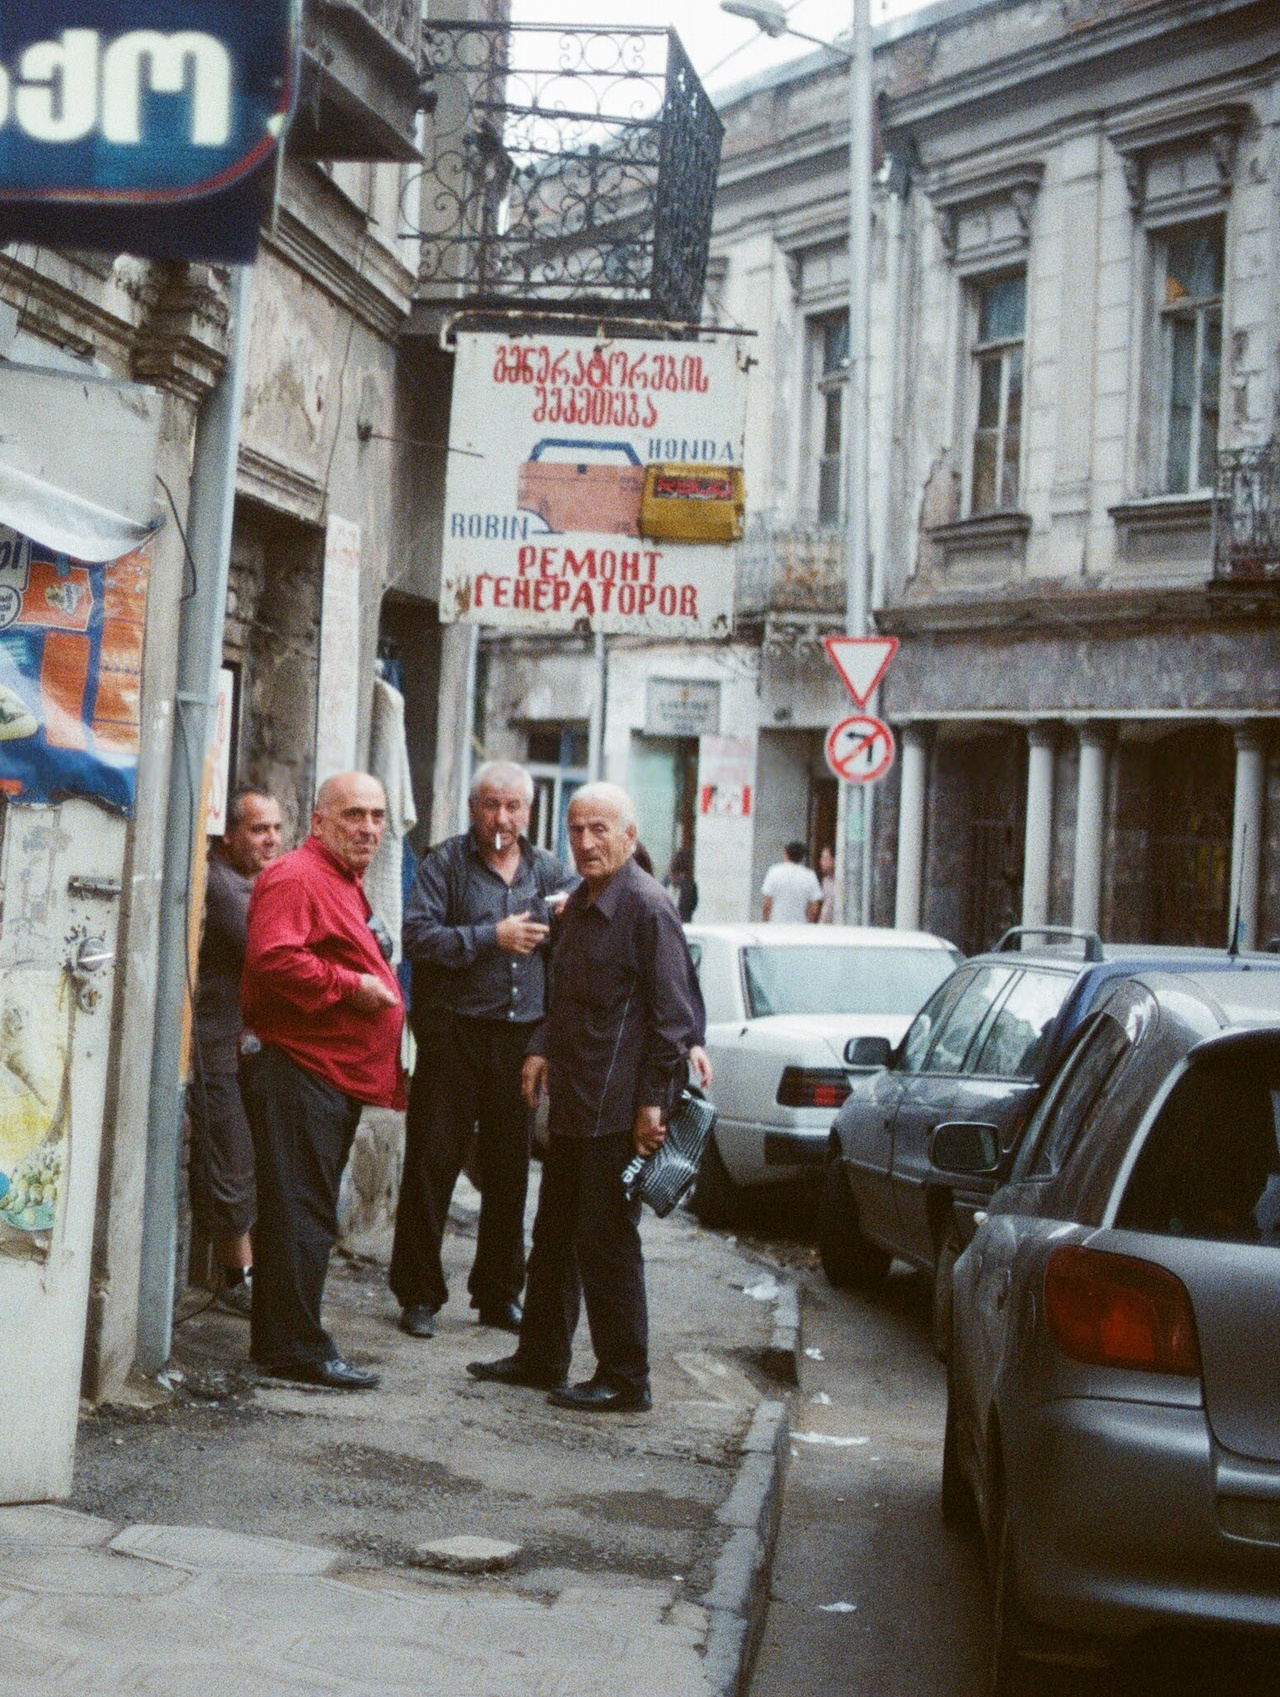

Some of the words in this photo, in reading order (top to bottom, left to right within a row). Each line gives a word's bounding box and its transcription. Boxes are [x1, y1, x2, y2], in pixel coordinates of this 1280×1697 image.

[493, 345, 709, 392] გენერატორების
[532, 384, 658, 428] შეკეთება
[648, 438, 734, 460] HONDA
[451, 512, 529, 540] ROBIN
[518, 545, 663, 583] РЕМОНТ
[474, 574, 698, 617] ГЕНЕРАТОРОВ
